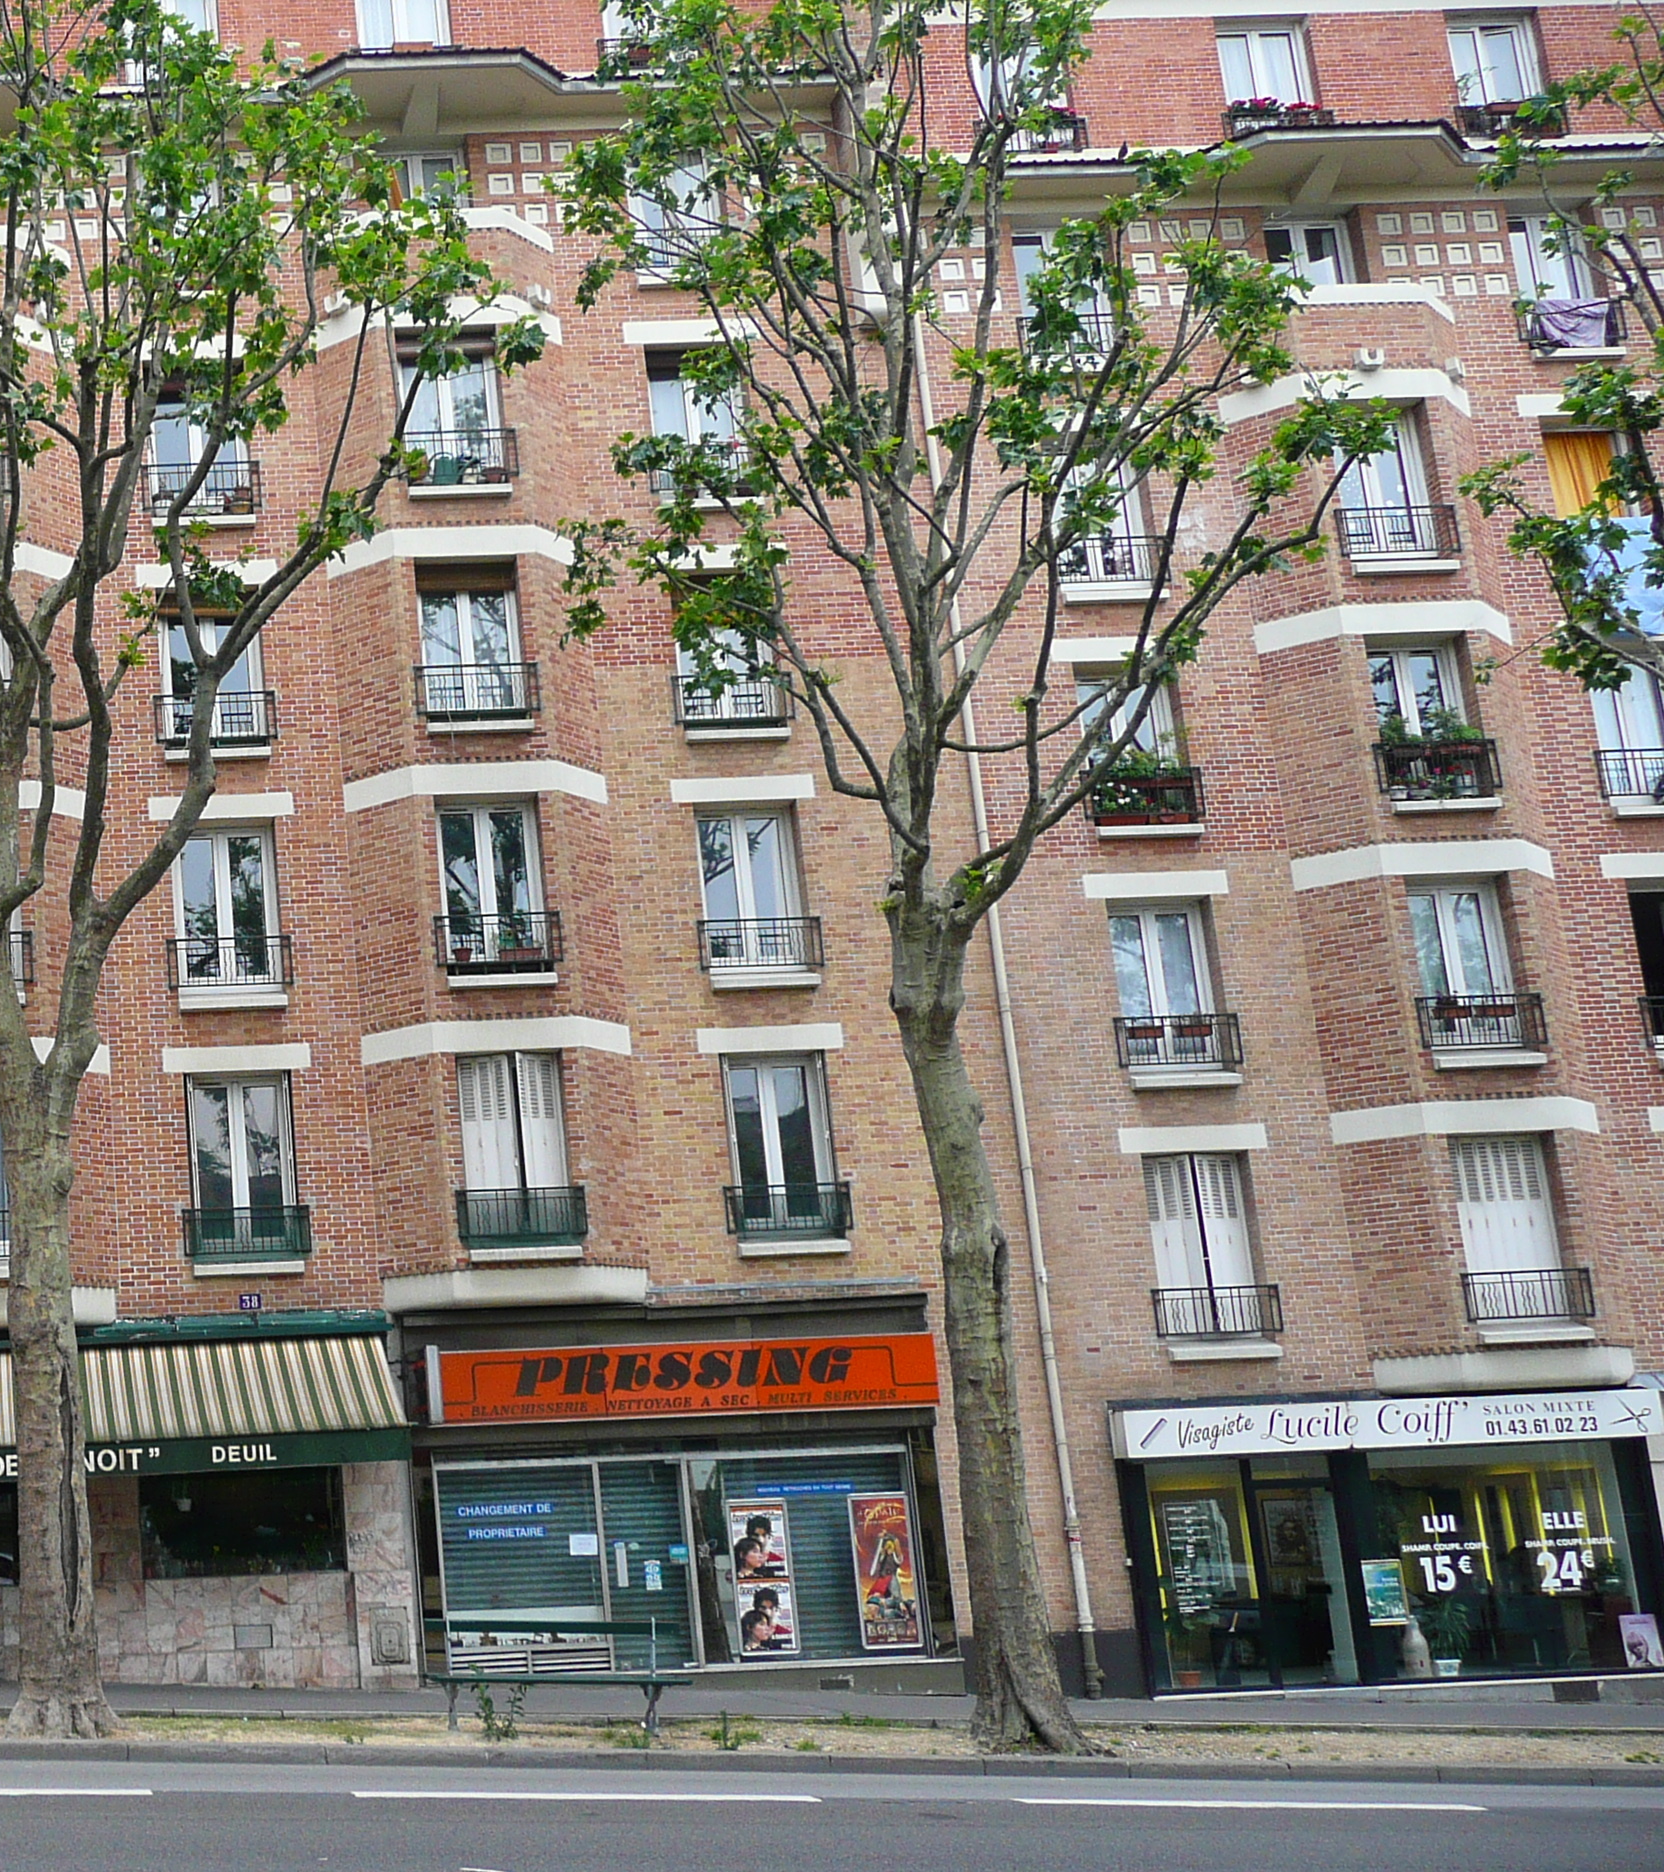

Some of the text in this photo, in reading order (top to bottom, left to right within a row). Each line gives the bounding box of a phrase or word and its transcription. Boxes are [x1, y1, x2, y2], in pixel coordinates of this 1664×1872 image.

[242, 1295, 258, 1309] 38
[514, 1346, 854, 1396] PRESSING
[471, 1387, 898, 1418] BLANCHISSERIE NETTOYAGE A SEC MULTI SERVICES
[1482, 1398, 1596, 1417] SALON MIXTE
[1176, 1413, 1255, 1450] Visagiste
[1260, 1402, 1360, 1445] Lucile
[212, 1443, 278, 1464] DEUIL
[458, 1502, 552, 1517] CHANGEMENT DE
[1421, 1514, 1456, 1533] LUI
[1541, 1511, 1585, 1530] ELLE
[468, 1526, 545, 1539] PROPRIETAIRE
